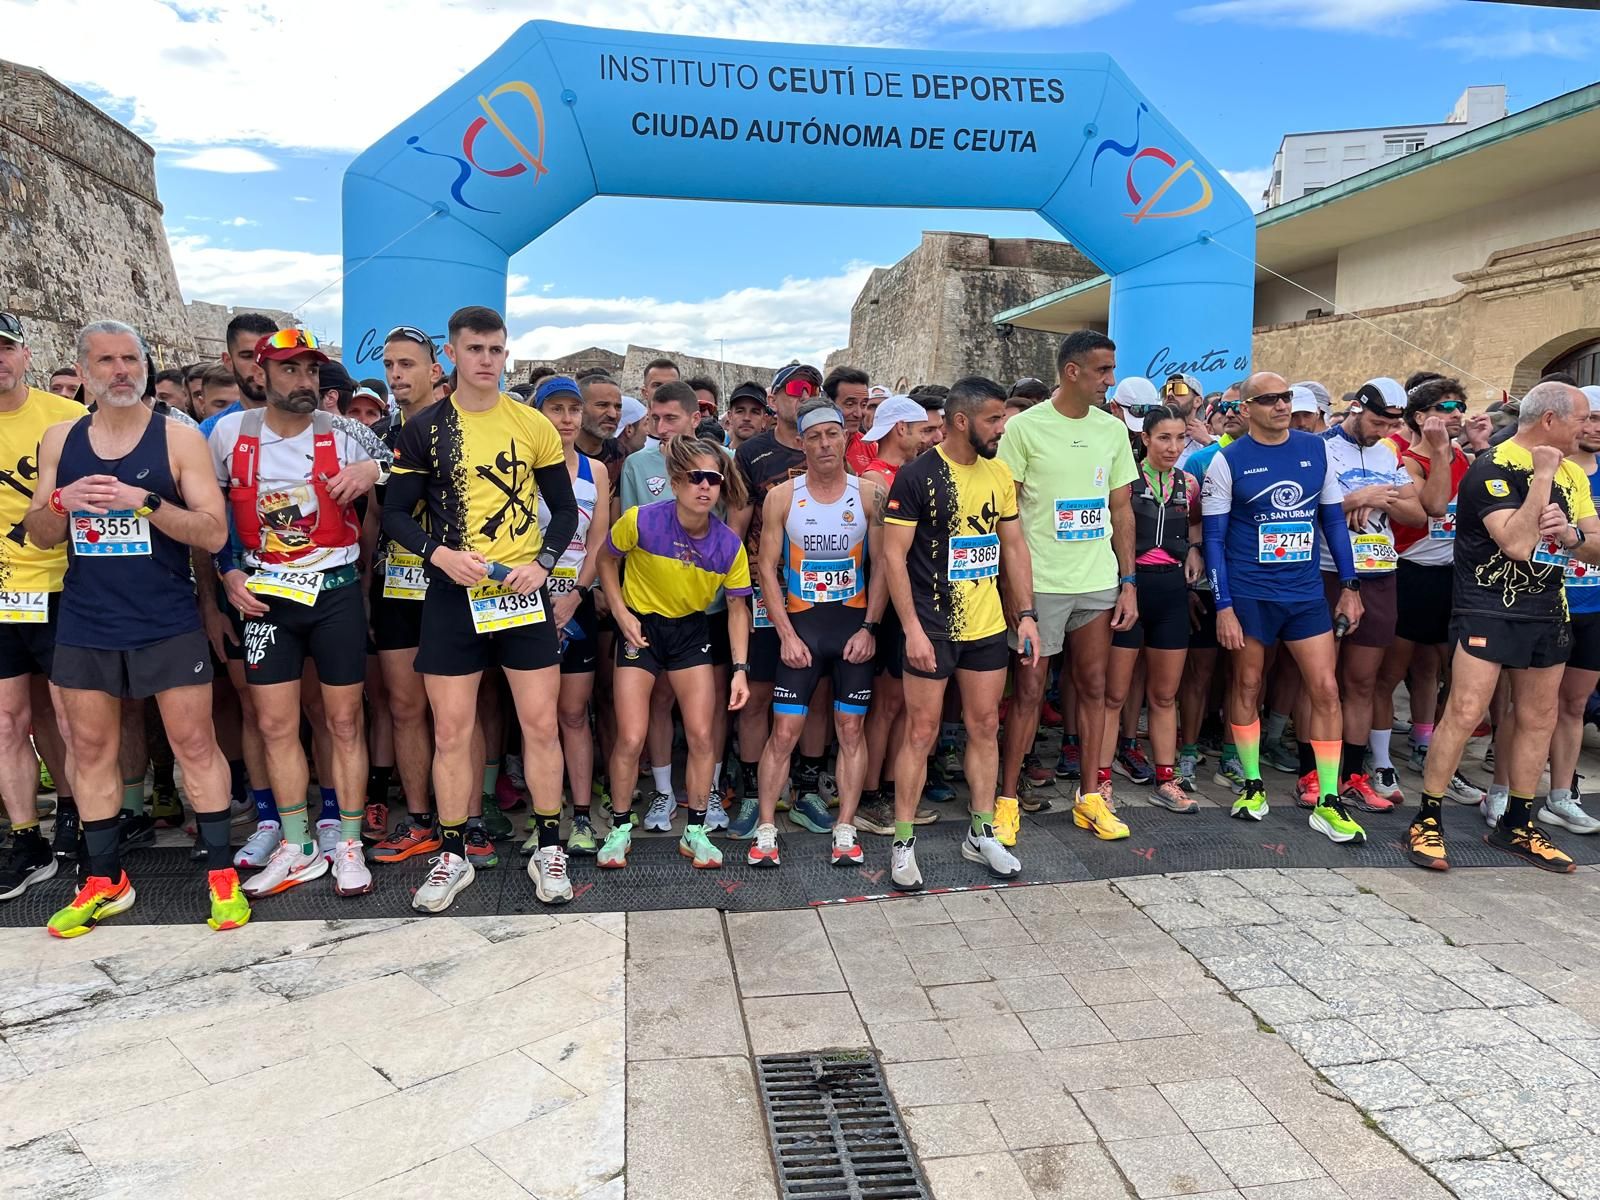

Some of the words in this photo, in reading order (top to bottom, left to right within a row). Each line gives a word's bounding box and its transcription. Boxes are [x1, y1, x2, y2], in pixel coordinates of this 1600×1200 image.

[601, 54, 758, 90] INSTITUTO
[768, 66, 855, 96] CEUTÍ
[864, 71, 903, 98] DE
[912, 73, 1065, 104] DEPORTES
[632, 112, 738, 141] CIUDAD
[745, 116, 902, 149] AUTÓNOMA
[910, 127, 945, 150] DE
[953, 128, 1037, 153] CEUTA
[1145, 346, 1229, 379] Ceuta
[1080, 509, 1101, 525] 664
[1254, 512, 1269, 522] C.D.
[1270, 511, 1288, 520] SAN
[95, 518, 141, 536] 3551
[803, 534, 849, 552] BERMEJO
[1280, 533, 1311, 548] 2714
[970, 545, 997, 564] 3869
[952, 560, 968, 568] 20K
[824, 570, 849, 586] 916
[498, 591, 538, 613] 4389
[244, 621, 277, 645] NEVER
[244, 634, 269, 651] GIVE
[247, 649, 265, 664] UP
